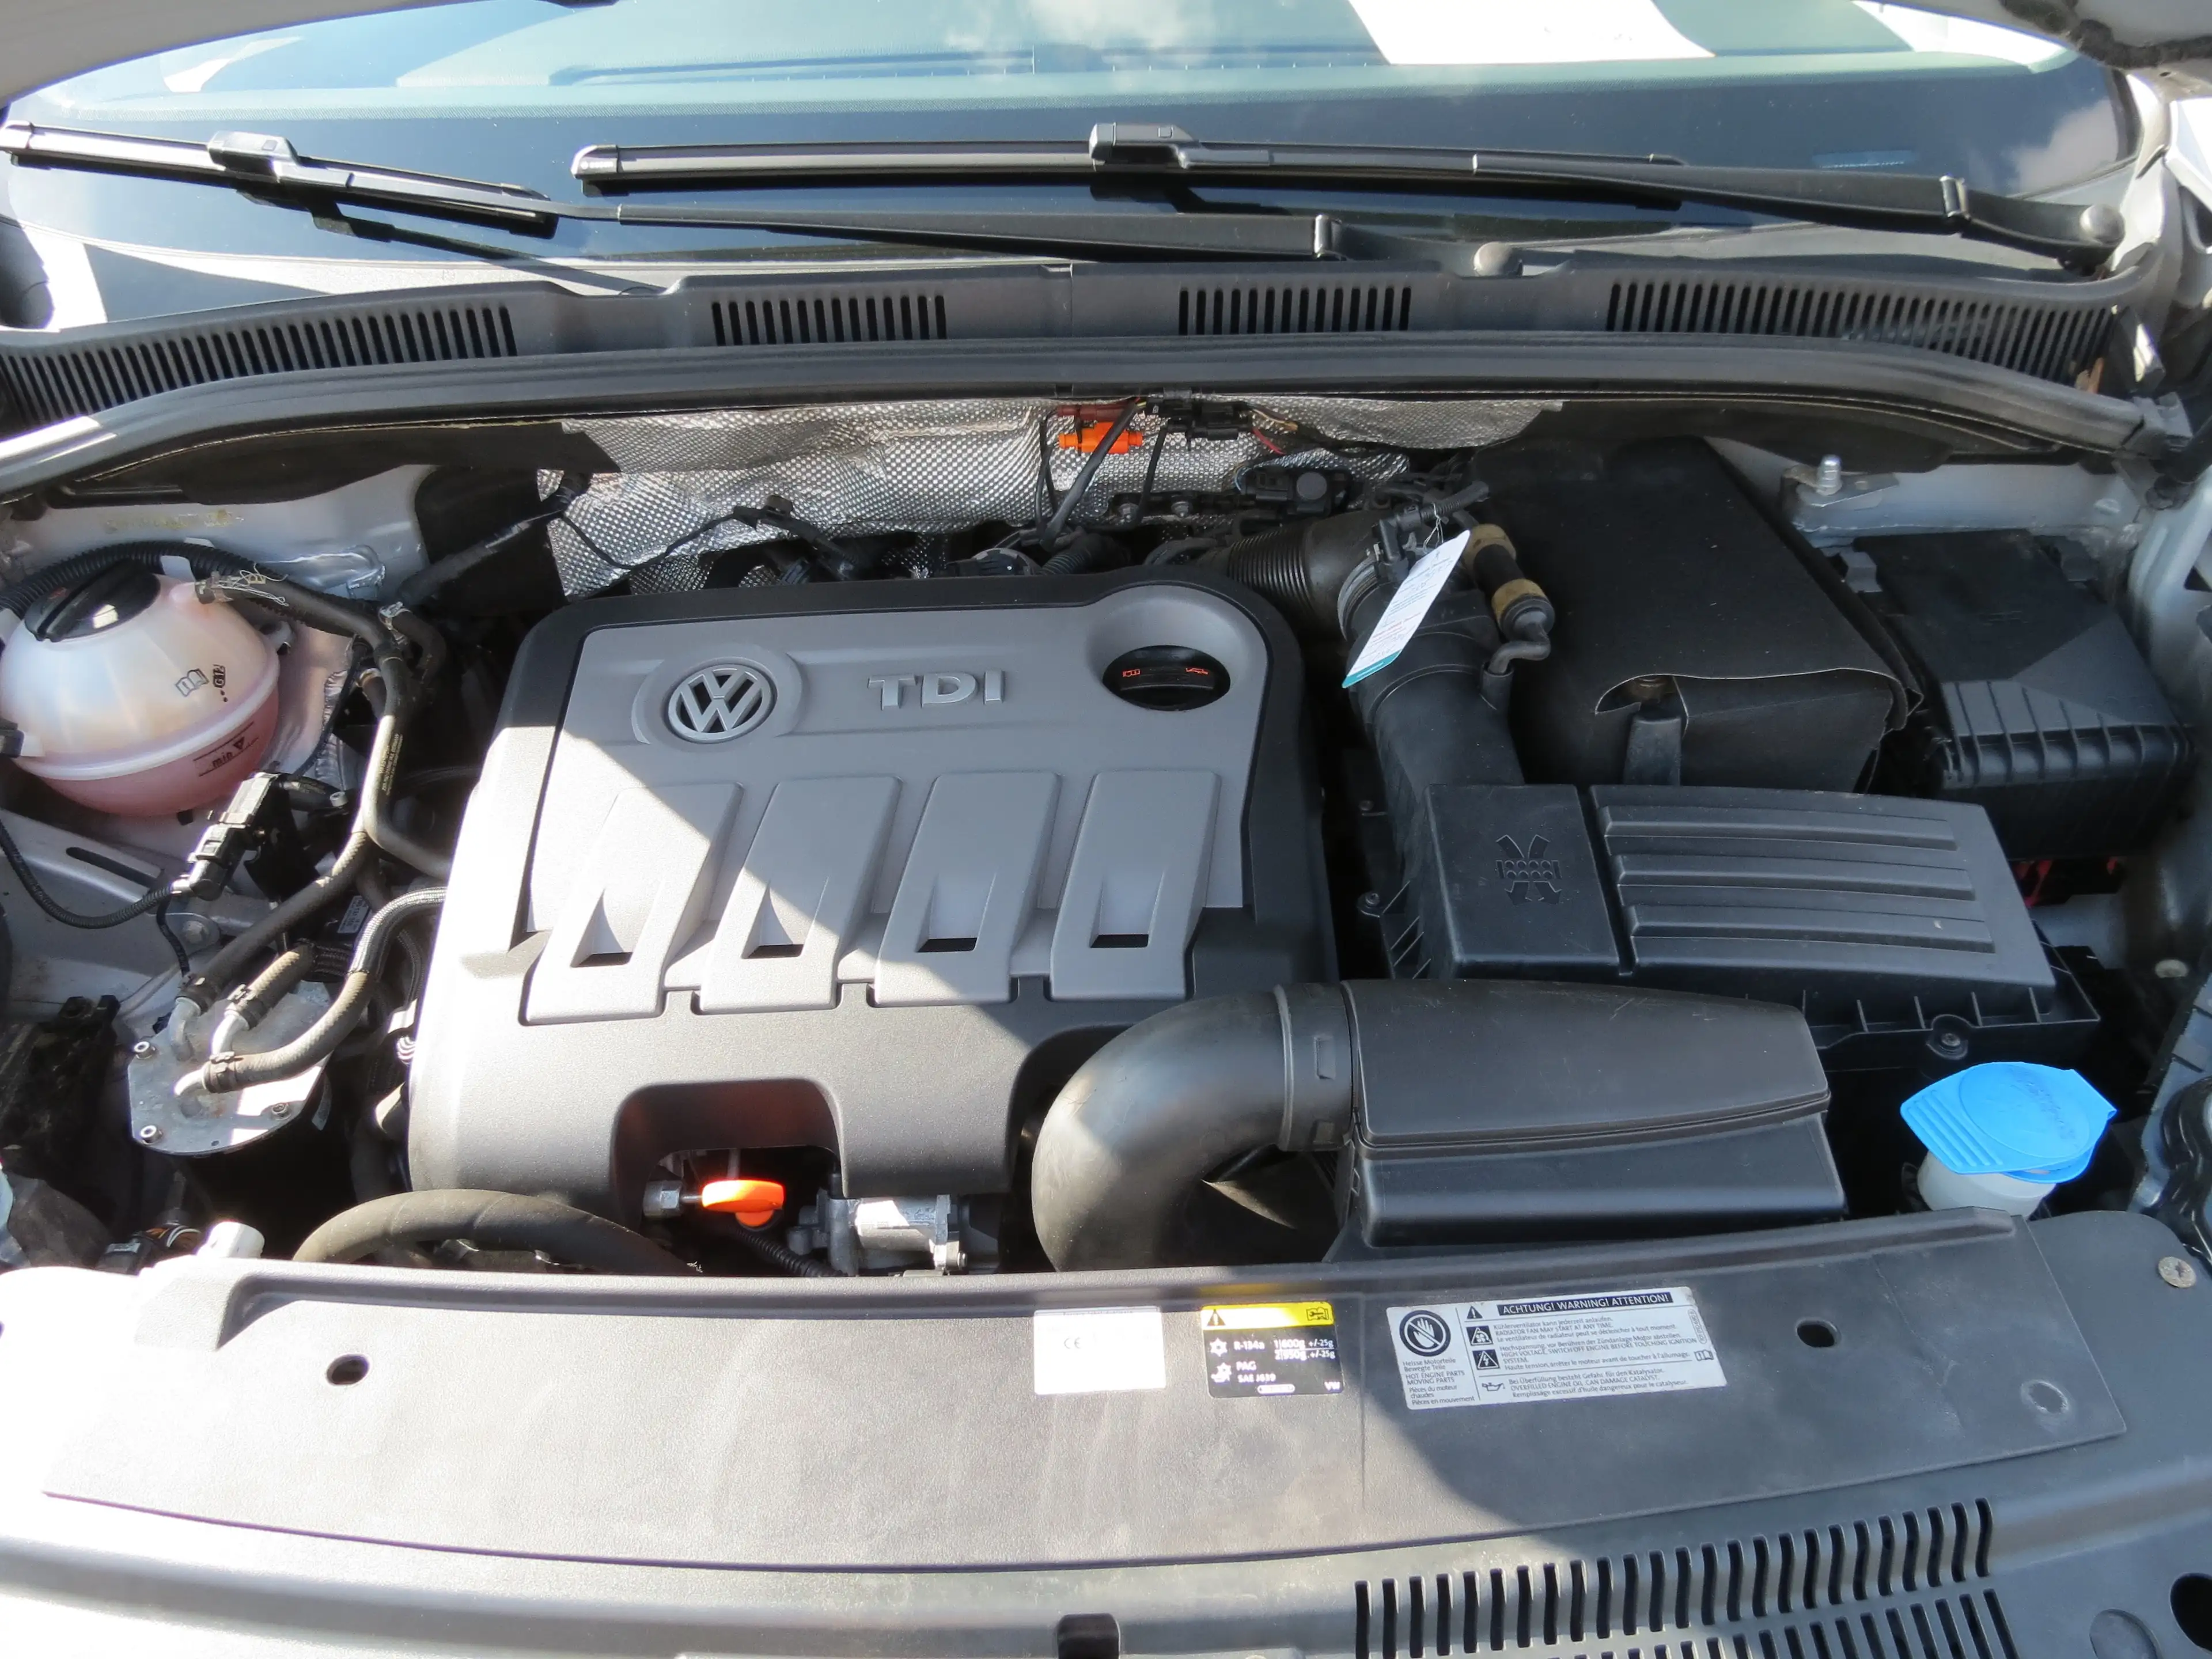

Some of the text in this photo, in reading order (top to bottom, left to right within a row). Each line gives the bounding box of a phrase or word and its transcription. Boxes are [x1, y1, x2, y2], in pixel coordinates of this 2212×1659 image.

[867, 670, 1005, 710] TDI
[213, 752, 233, 768] min
[1503, 1294, 1669, 1314] ACHTUNG! WARNING! ATTENTION!
[1494, 1321, 1541, 1330] Kühlerventilator
[1558, 1318, 1584, 1326] jederzeit
[1495, 1328, 1525, 1336] RADIATOR
[1576, 1330, 1590, 1338] peut
[1599, 1327, 1630, 1335] déclencher
[1234, 1340, 1265, 1350] R-134a
[1236, 1361, 1257, 1370] PAG
[1238, 1374, 1255, 1382] SAE
[1520, 1376, 1556, 1384] Überfüllung
[1513, 1389, 1551, 1397] Remplissage
[1599, 1384, 1631, 1392] dangereux
